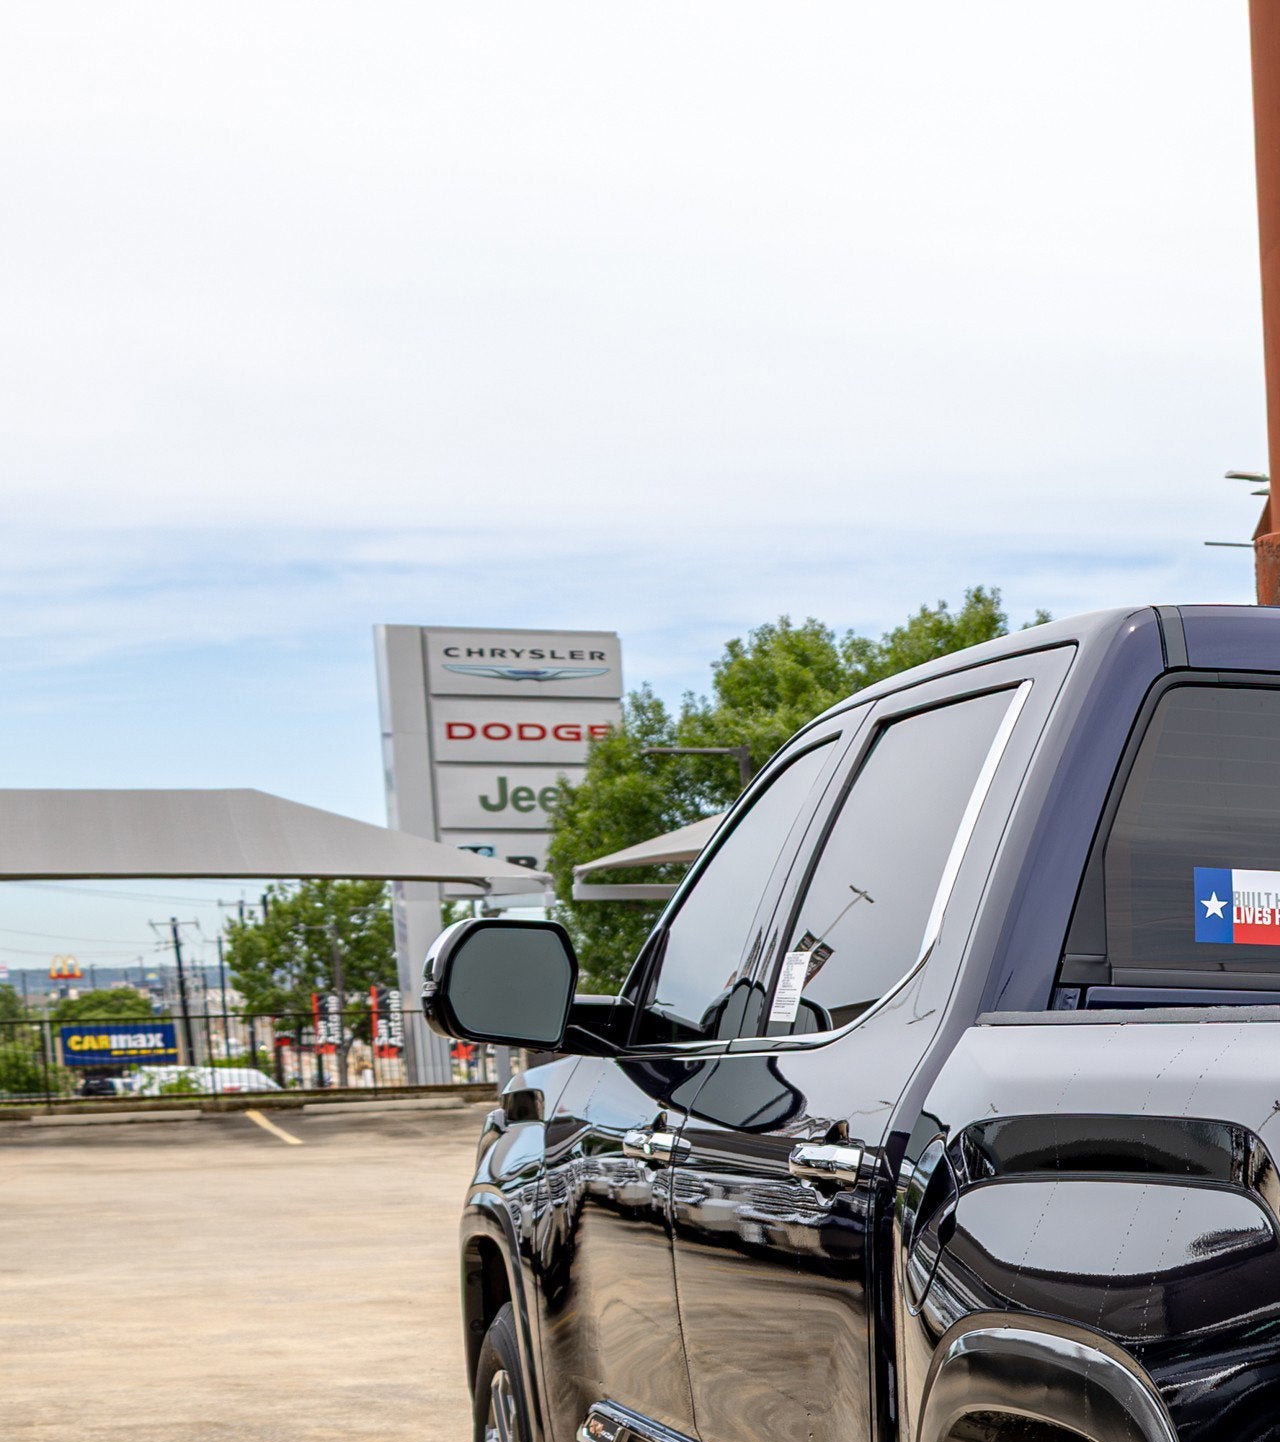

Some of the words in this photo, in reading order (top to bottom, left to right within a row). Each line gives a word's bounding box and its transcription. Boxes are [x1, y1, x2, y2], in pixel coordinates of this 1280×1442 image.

[443, 646, 607, 661] CHRYSLER
[445, 722, 613, 742] DODGE
[478, 776, 561, 813] Jee
[1233, 891, 1272, 908] BUILT
[1233, 907, 1272, 925] LIVES
[375, 1018, 389, 1046] San
[389, 990, 403, 1047] Antonio
